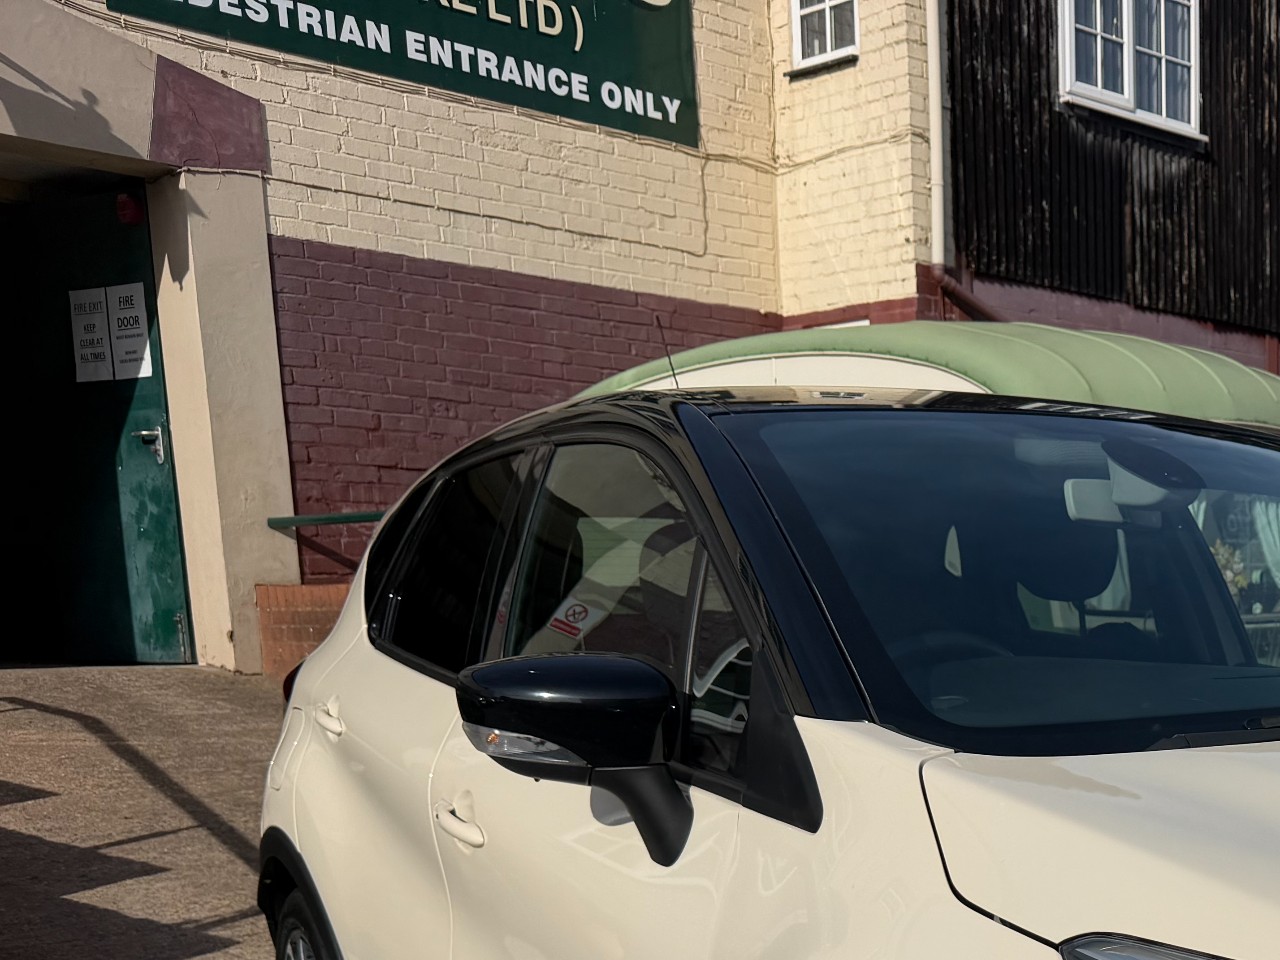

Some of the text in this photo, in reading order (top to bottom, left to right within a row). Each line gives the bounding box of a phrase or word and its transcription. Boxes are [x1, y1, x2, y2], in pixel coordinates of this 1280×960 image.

[405, 29, 590, 102] ENTRANCE
[601, 81, 681, 124] ONLY
[73, 301, 103, 313] FIRE EXIT
[118, 295, 135, 307] FIRE
[117, 315, 140, 328] DOOR
